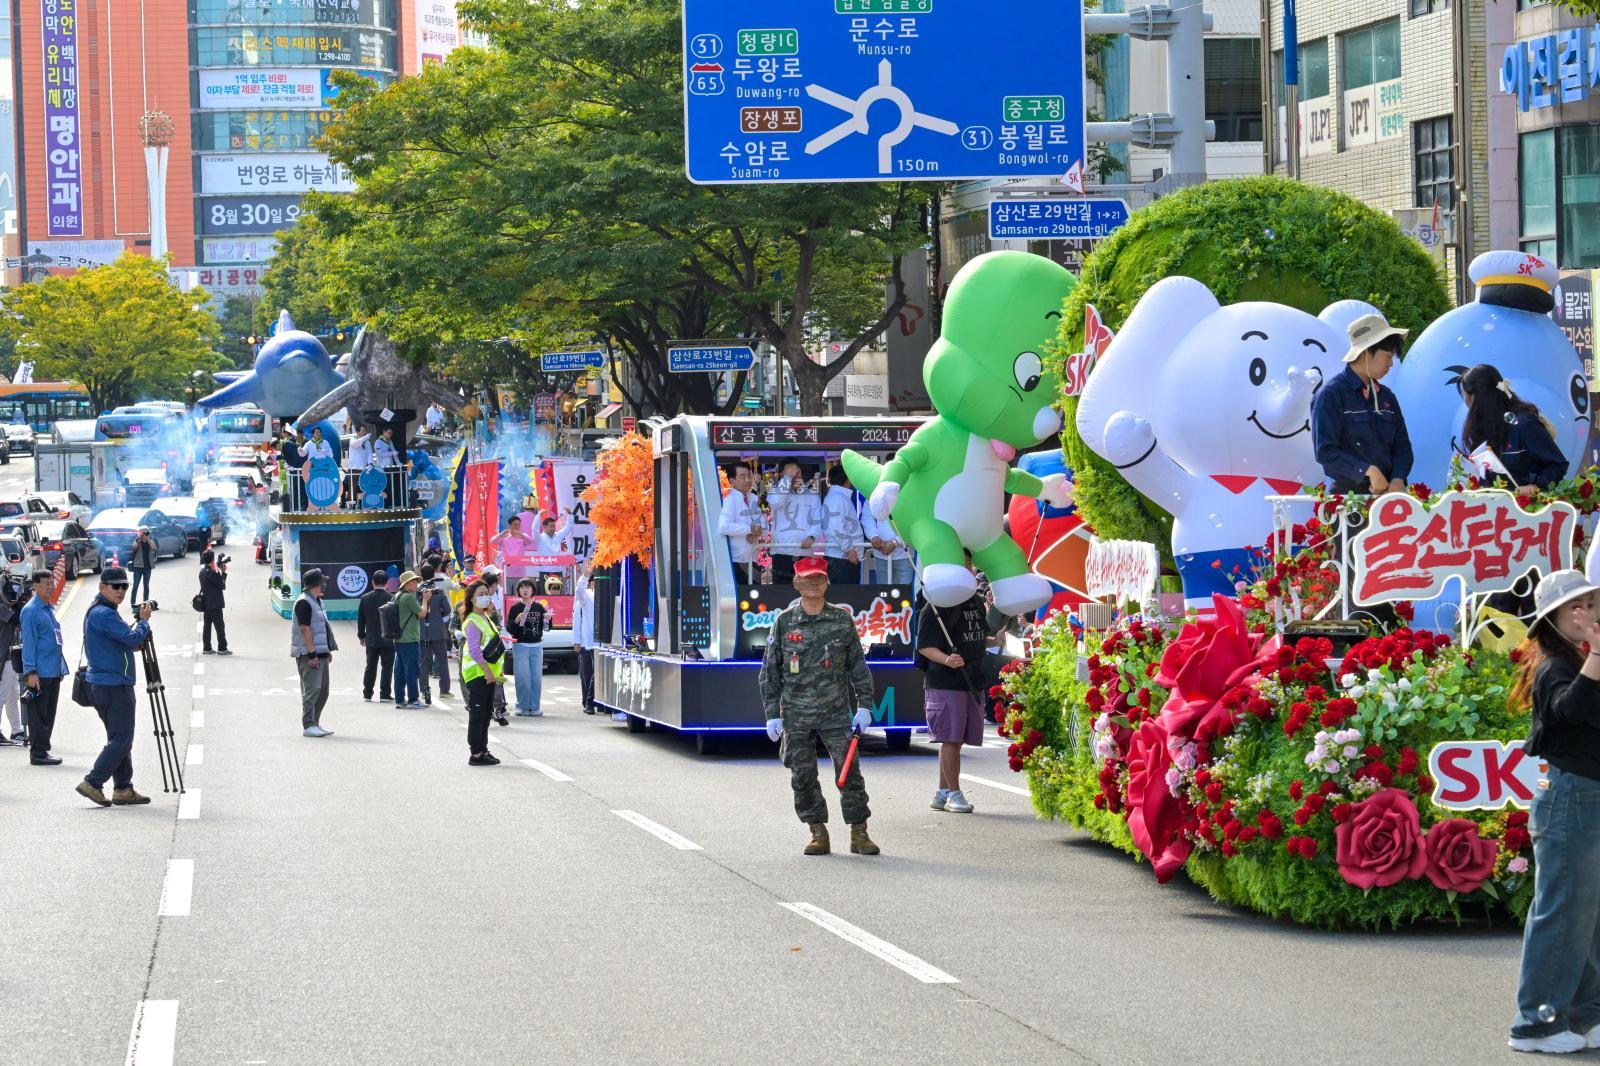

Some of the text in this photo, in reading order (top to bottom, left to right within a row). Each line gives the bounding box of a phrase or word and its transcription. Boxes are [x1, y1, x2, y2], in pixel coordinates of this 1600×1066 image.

[849, 18, 919, 42] 문수로
[697, 38, 716, 54] 31
[742, 33, 794, 52] 청량IC
[858, 43, 911, 55] Munsu-ro
[732, 57, 803, 83] 두왕로
[697, 76, 717, 90] 65
[736, 86, 800, 100] Duwang-ro
[1008, 99, 1061, 118] 중구청
[1349, 98, 1370, 138] JPT
[744, 110, 798, 129] 장생포
[967, 130, 988, 146] 31
[998, 124, 1069, 151] 봉월로
[719, 141, 790, 166] 수암로
[998, 153, 1069, 167] Bongwol-ro
[50, 115, 79, 212] 명안과
[731, 167, 779, 179] Suam-ro
[897, 158, 939, 172] 150m
[238, 165, 288, 185] 번영로
[293, 164, 338, 185] 하늘채
[1068, 172, 1079, 185] SK
[52, 215, 78, 228] 의원
[211, 204, 238, 225] 8월
[241, 203, 282, 225] 30일
[995, 224, 1108, 236] Samsan-ro 29beon-gil
[1517, 263, 1533, 276] SK
[1064, 353, 1092, 396] SK
[1360, 498, 1570, 601] 울산답게
[1437, 747, 1535, 803] SK
